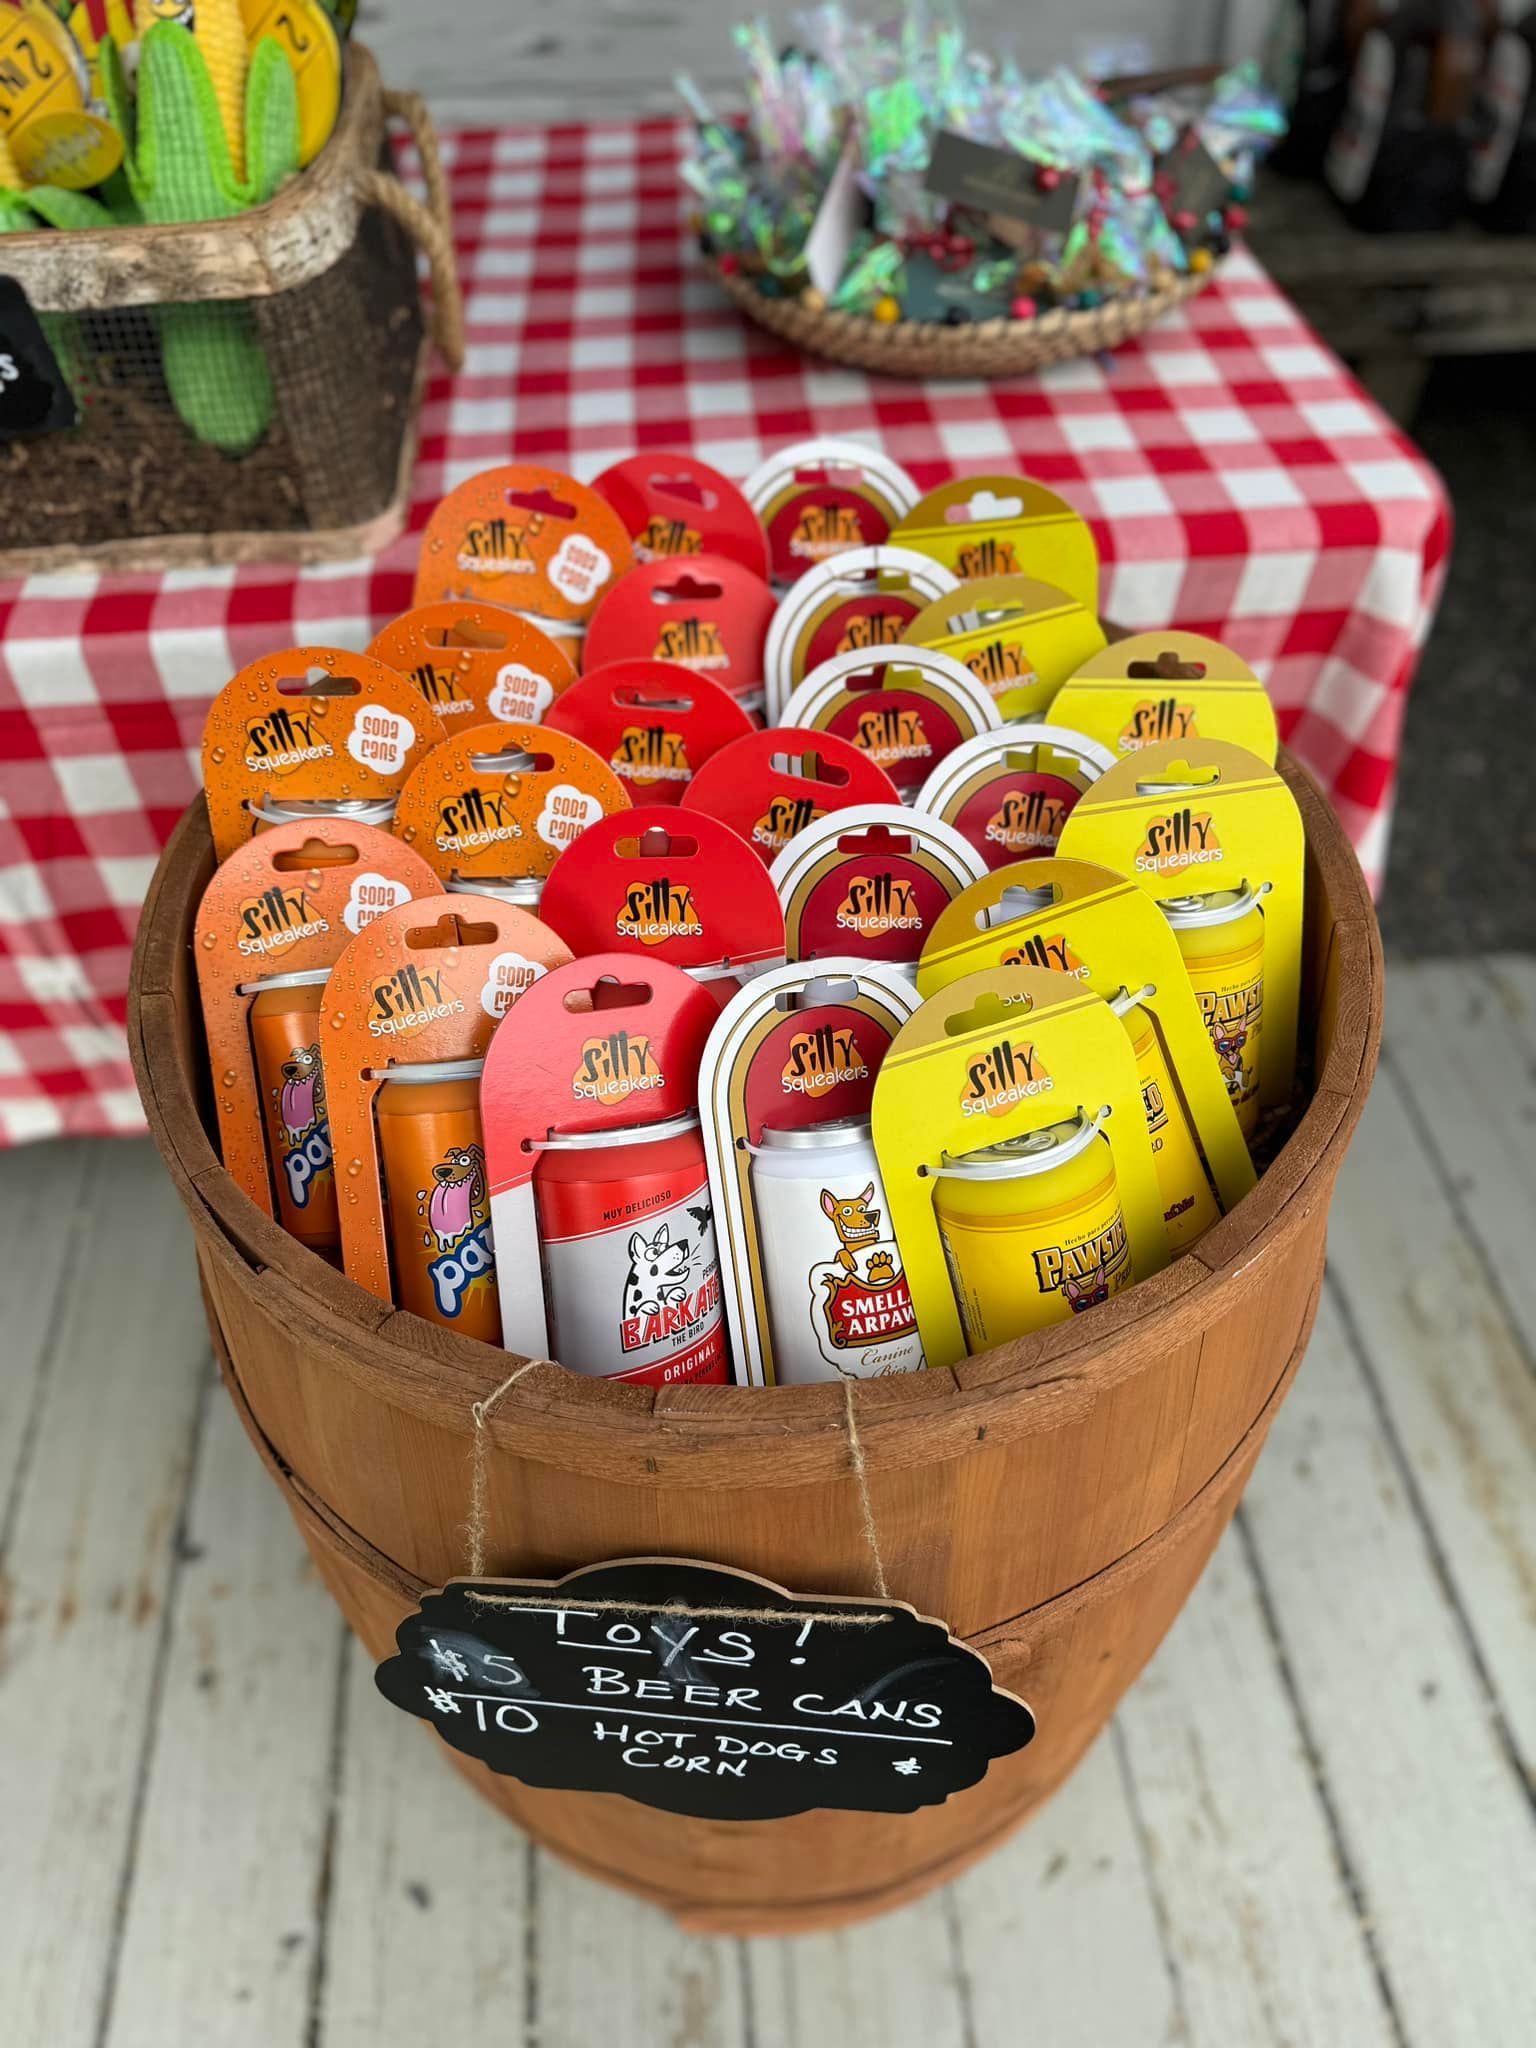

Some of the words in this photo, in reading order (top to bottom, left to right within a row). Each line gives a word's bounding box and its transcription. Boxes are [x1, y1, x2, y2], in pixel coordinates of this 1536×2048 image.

[249, 707, 313, 757] Silly
[620, 724, 684, 768] Silly
[244, 743, 334, 773] Squeakers
[441, 786, 504, 837] Silly
[435, 822, 523, 853] Squeakers
[1145, 808, 1213, 858] Silly
[1134, 847, 1224, 873] Squeakers
[242, 886, 309, 940] Silly
[625, 877, 691, 924] Silly
[846, 872, 912, 916] Silly
[237, 917, 330, 957] Squeakers
[615, 919, 704, 939] Squeakers
[836, 912, 923, 931] Squeakers
[373, 963, 443, 1020] Silly
[368, 999, 465, 1038] Squeakers
[582, 1030, 650, 1083] Silly
[790, 1024, 855, 1077] Silly
[968, 1040, 1034, 1099] Silly
[572, 1073, 665, 1101] Squeakers
[781, 1064, 870, 1095] Squeakers
[960, 1075, 1054, 1118] Squeakers
[603, 1207, 622, 1222] MUY
[625, 1189, 672, 1215] DELICIOSO
[671, 1331, 688, 1347] THE
[688, 1321, 705, 1340] BIRD
[663, 1341, 716, 1382] ORIGINAL
[860, 1346, 914, 1367] Canine
[581, 1664, 763, 1712] BEER
[792, 1692, 943, 1730] CANS
[593, 1721, 698, 1749] HOT
[713, 1735, 840, 1767] DOGS
[621, 1746, 747, 1778] CORN
